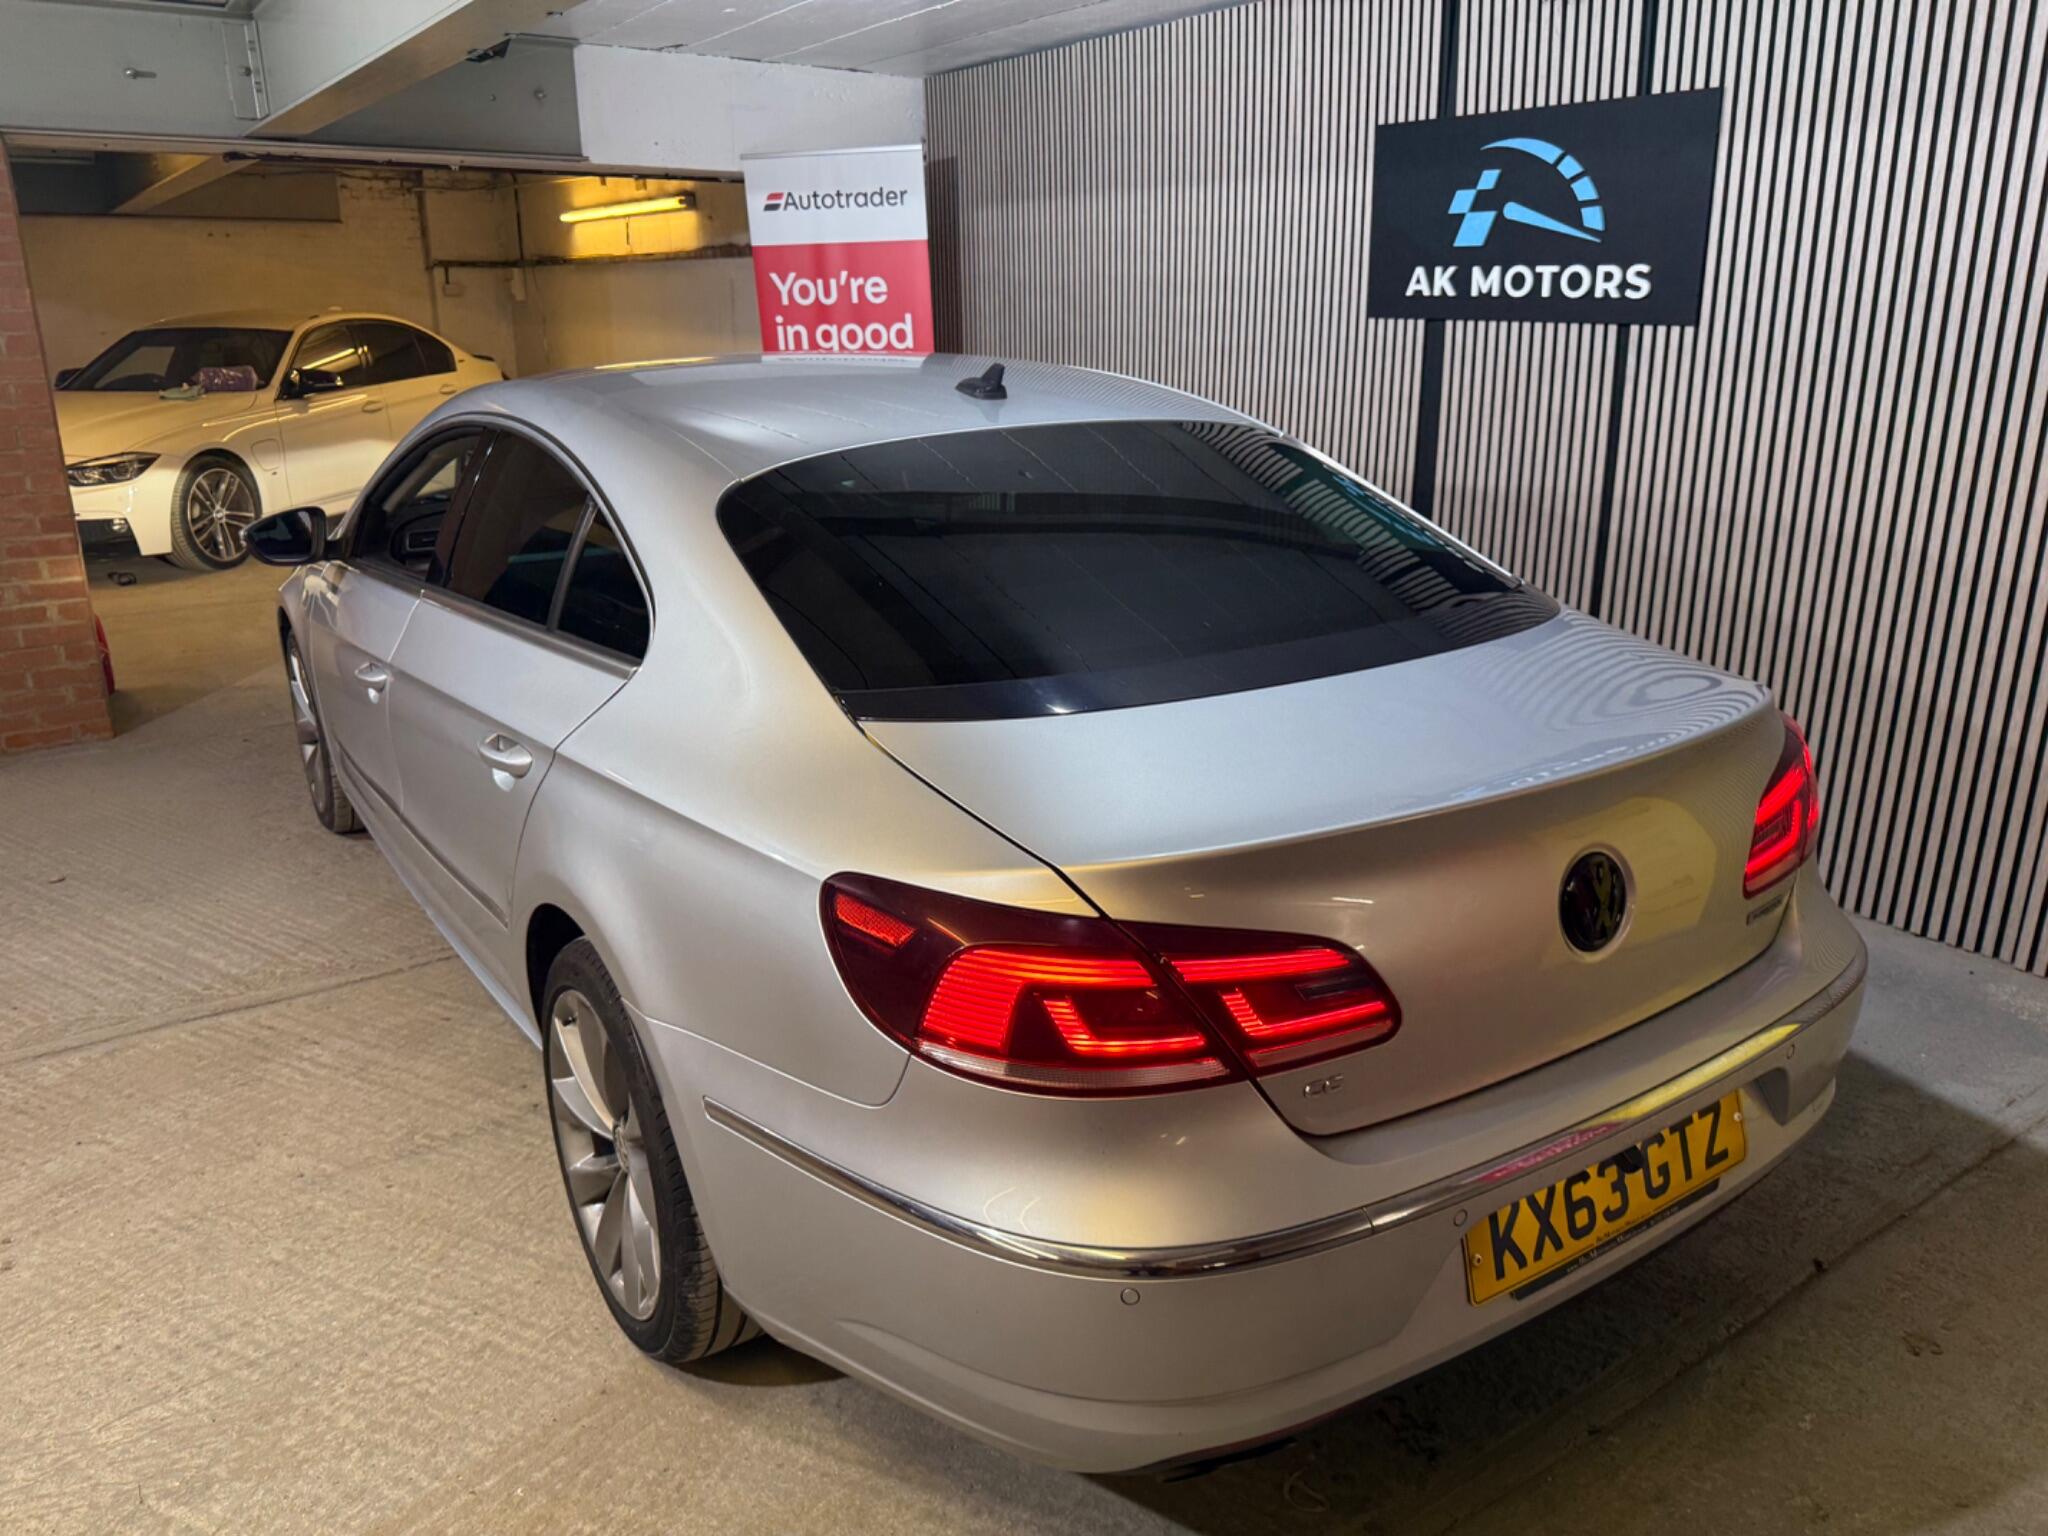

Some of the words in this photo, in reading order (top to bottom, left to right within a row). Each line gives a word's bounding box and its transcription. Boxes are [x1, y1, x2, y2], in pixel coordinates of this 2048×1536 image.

[783, 187, 908, 212] Autotrader
[769, 270, 889, 306] You're
[1405, 265, 1459, 297] AK
[1470, 263, 1652, 300] MOTORS
[775, 315, 810, 351] in
[815, 312, 914, 353] good
[1488, 1154, 1630, 1281] KX63
[1640, 1098, 1729, 1200] GTZ
